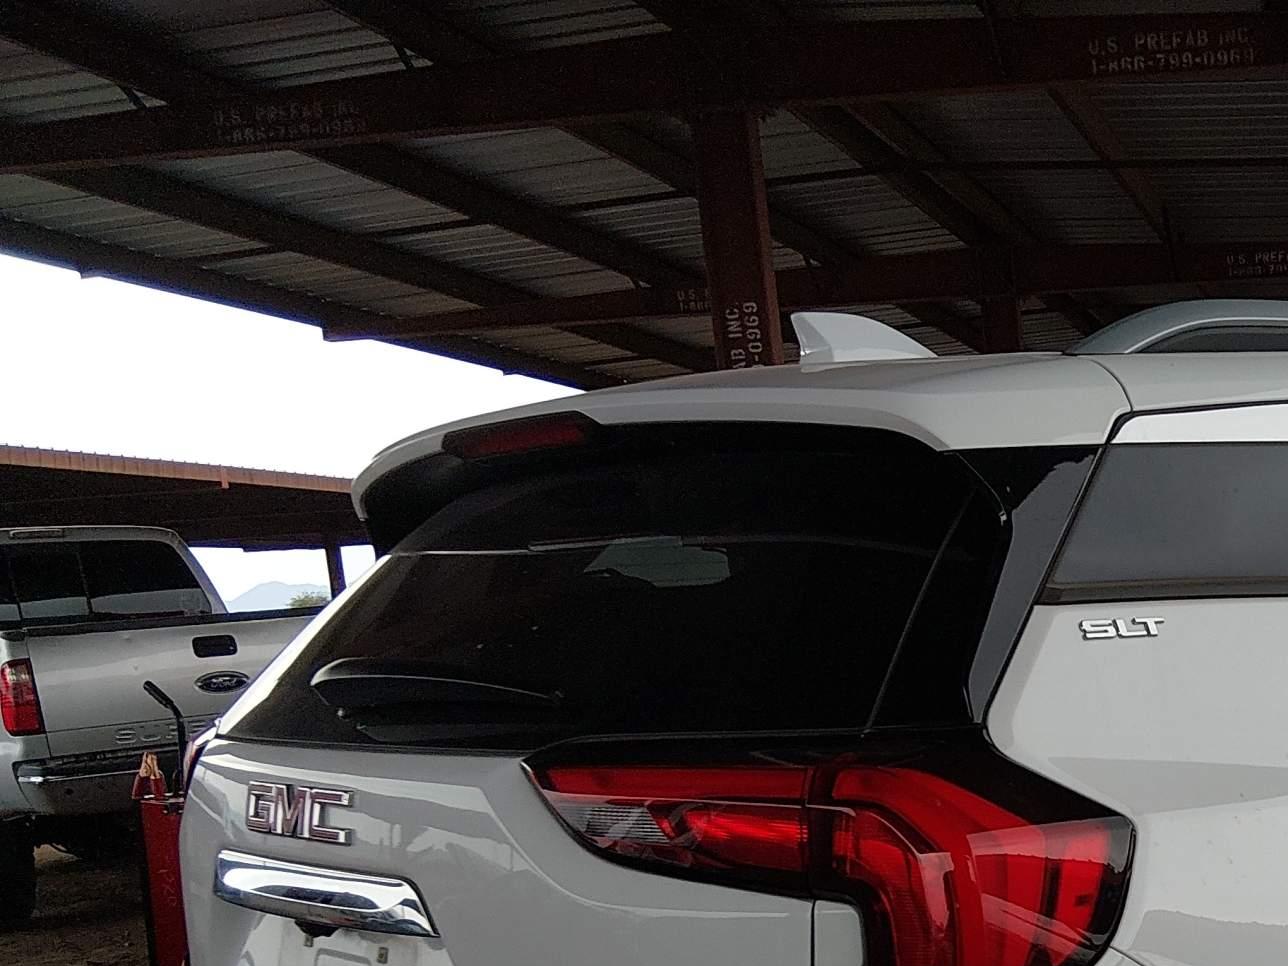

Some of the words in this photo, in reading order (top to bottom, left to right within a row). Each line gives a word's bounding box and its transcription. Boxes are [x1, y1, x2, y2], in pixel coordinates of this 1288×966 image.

[1134, 28, 1210, 51] PREFAB
[1079, 616, 1165, 641] SLT
[246, 780, 355, 847] GMC
